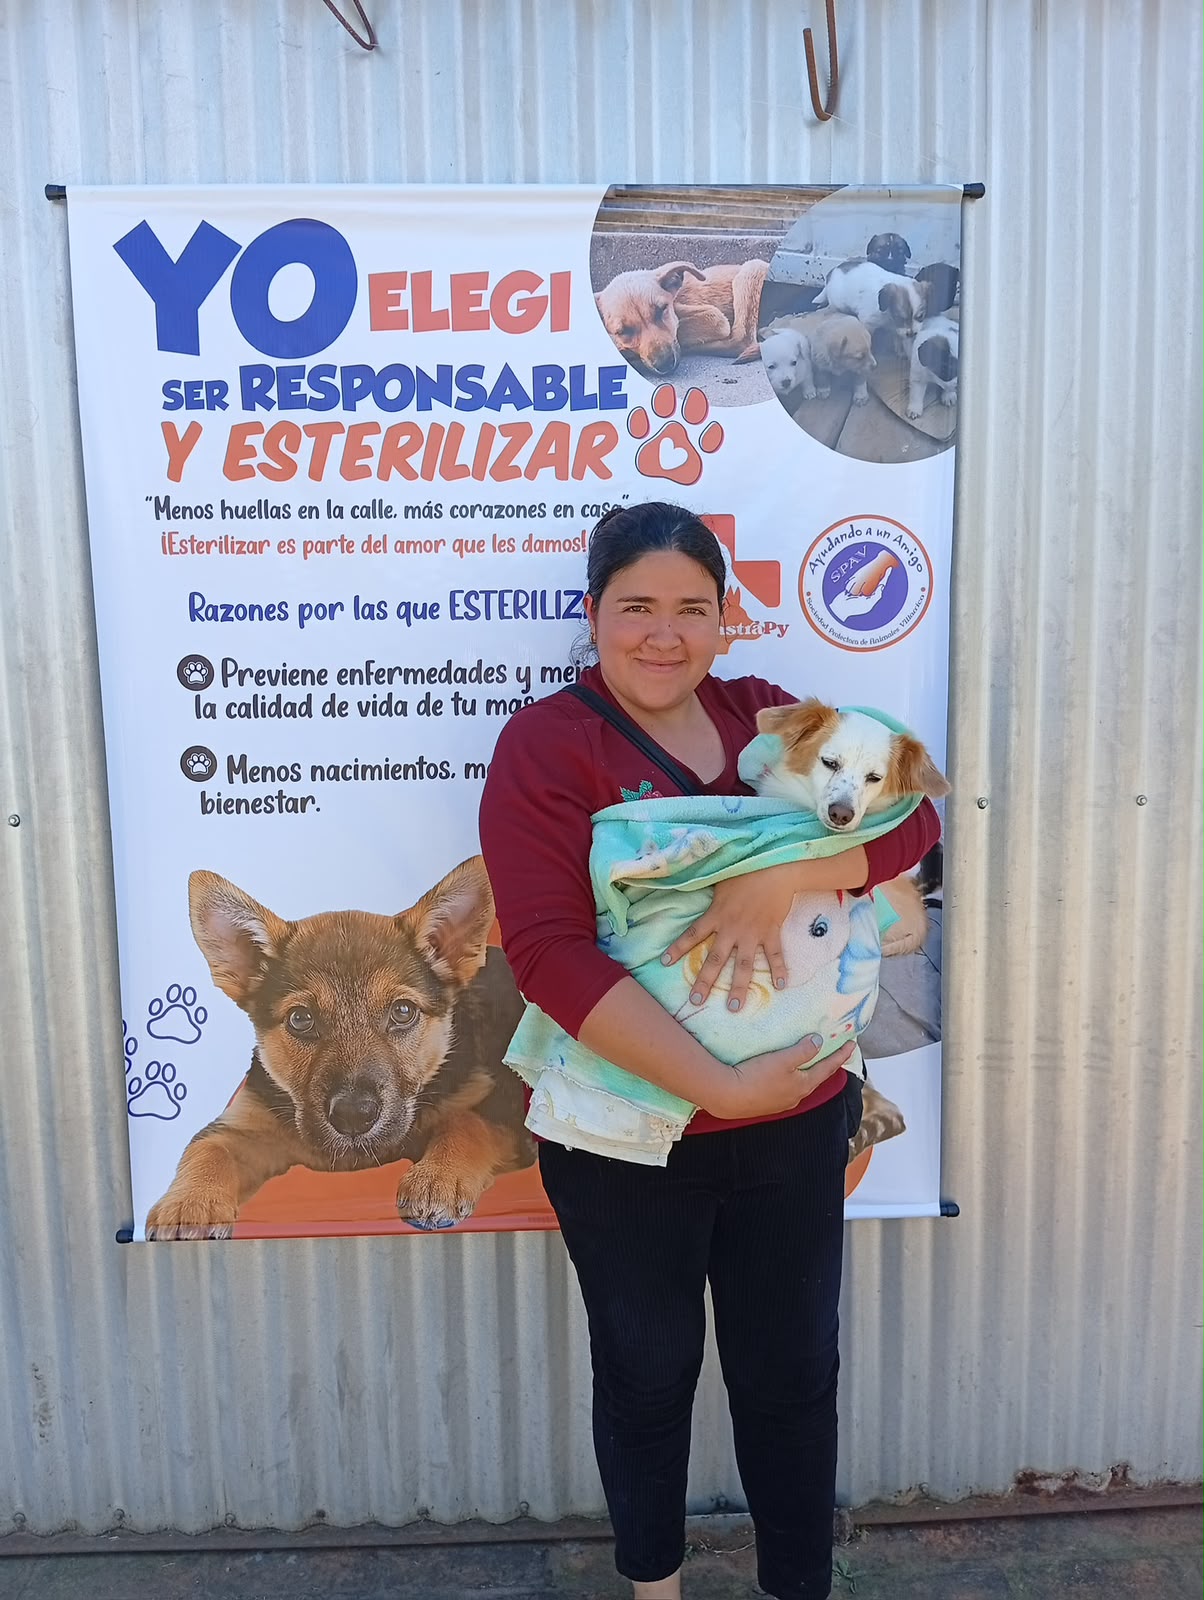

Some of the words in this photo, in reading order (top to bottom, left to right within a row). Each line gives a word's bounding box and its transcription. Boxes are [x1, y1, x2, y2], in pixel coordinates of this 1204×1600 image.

[113, 217, 358, 359] YO
[368, 270, 572, 334] ELEGI
[162, 379, 229, 411] SER
[239, 362, 628, 412] RESPONSABLE
[160, 420, 203, 482] Y
[222, 419, 620, 482] ESTERILIZAR
[220, 497, 292, 520] huellas
[297, 504, 320, 520] en
[326, 498, 344, 520] la
[404, 500, 443, 519] más
[449, 502, 547, 520] corazones
[553, 503, 575, 519] en
[277, 540, 297, 555] es
[303, 535, 356, 561] parte
[362, 534, 389, 555] del
[395, 539, 447, 555] amor
[453, 538, 486, 560] que
[492, 533, 516, 554] les
[523, 529, 587, 554] damos!
[809, 524, 862, 575] Ayudando
[865, 527, 872, 536] a
[876, 528, 891, 539] un
[892, 534, 923, 573] Amigo
[830, 544, 867, 583] SPAV
[188, 591, 289, 622] Razones
[298, 600, 345, 629] por
[353, 594, 388, 621] las
[396, 600, 441, 628] que
[449, 588, 588, 621] ESTERILIZ
[828, 627, 859, 645] Protectora
[221, 657, 329, 688] Previene
[336, 658, 507, 687] enfermedades
[515, 666, 531, 694] y
[540, 660, 592, 683] mej
[194, 694, 218, 720] la
[225, 692, 313, 720] calidad
[321, 692, 349, 719] de
[357, 691, 408, 718] vida
[416, 691, 444, 718] de
[450, 691, 477, 717] tu
[227, 753, 302, 785] Menos
[200, 790, 321, 816] bienestar.
